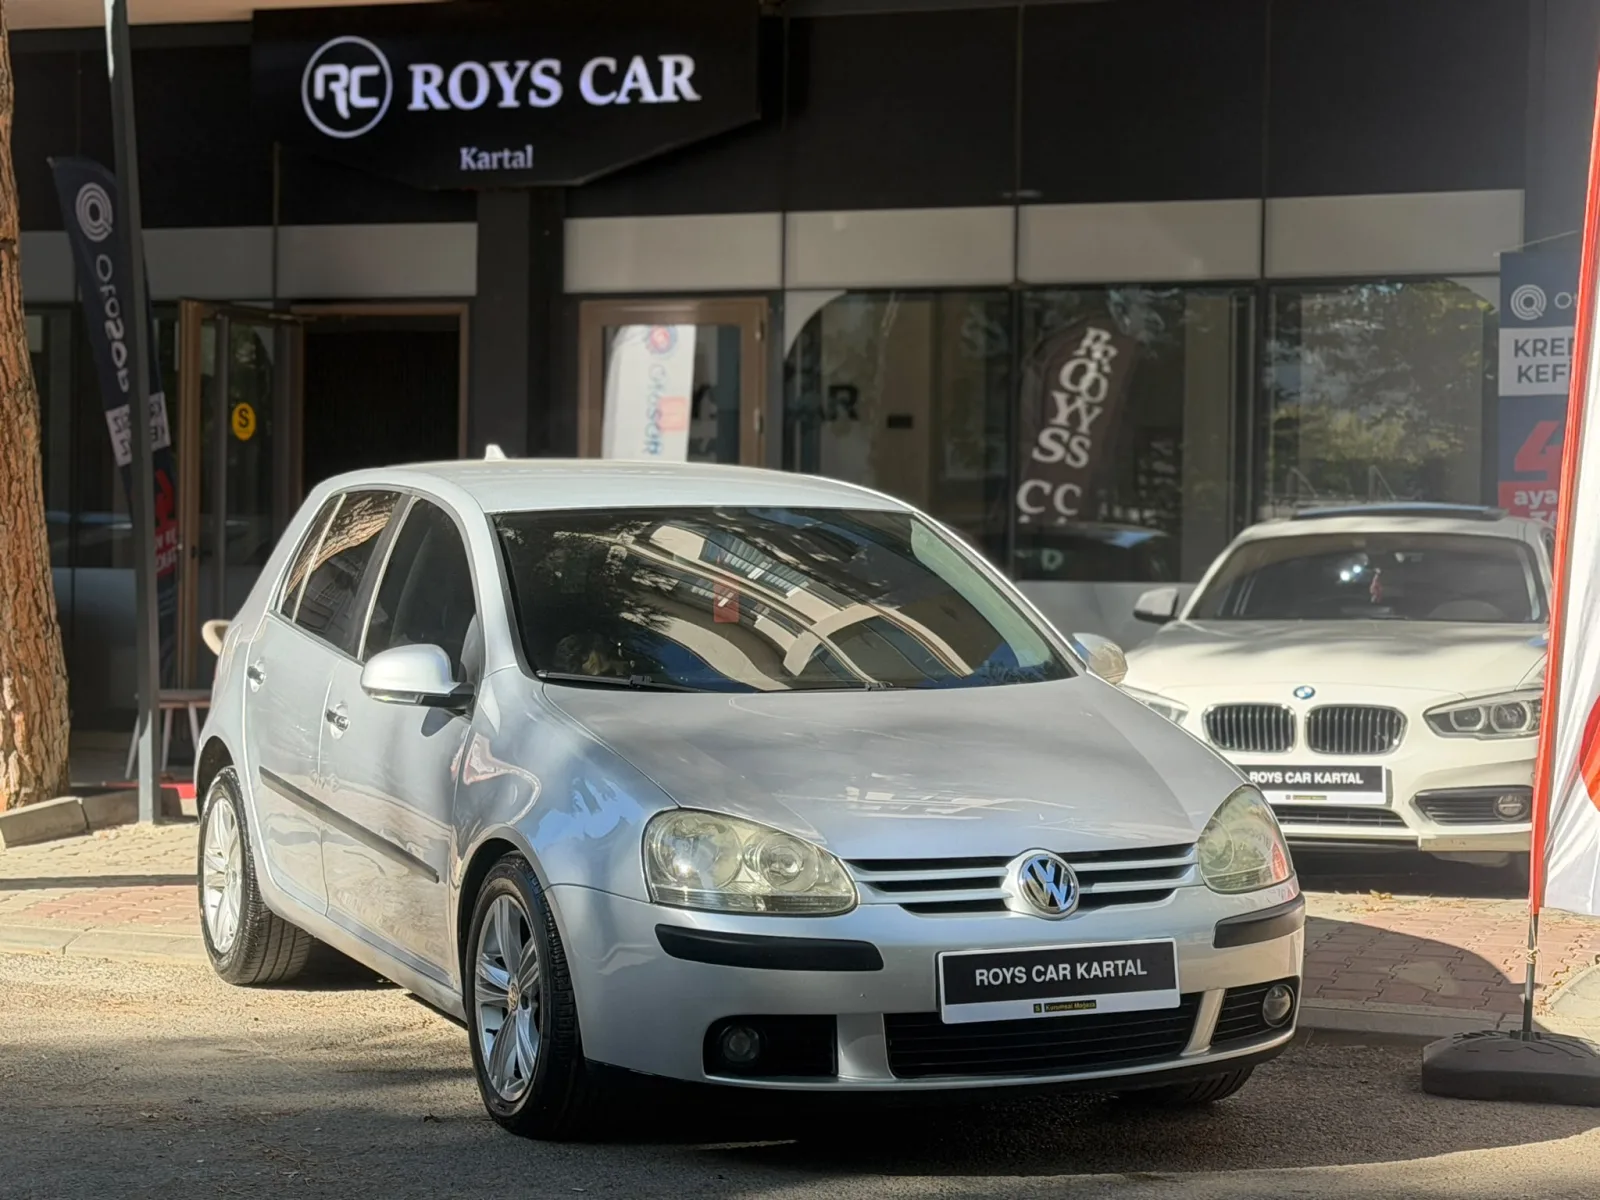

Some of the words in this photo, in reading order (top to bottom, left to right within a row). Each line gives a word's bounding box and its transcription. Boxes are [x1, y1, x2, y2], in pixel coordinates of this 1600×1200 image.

[407, 59, 562, 111] ROYS
[579, 54, 701, 105] CAR
[460, 145, 533, 170] Kartal
[1249, 771, 1282, 783] ROYS
[1285, 772, 1311, 784] CAR
[1314, 772, 1364, 785] KARTAL
[975, 967, 1027, 986] ROYS
[1032, 963, 1071, 983] CAR
[1076, 958, 1147, 980] KARTAL
